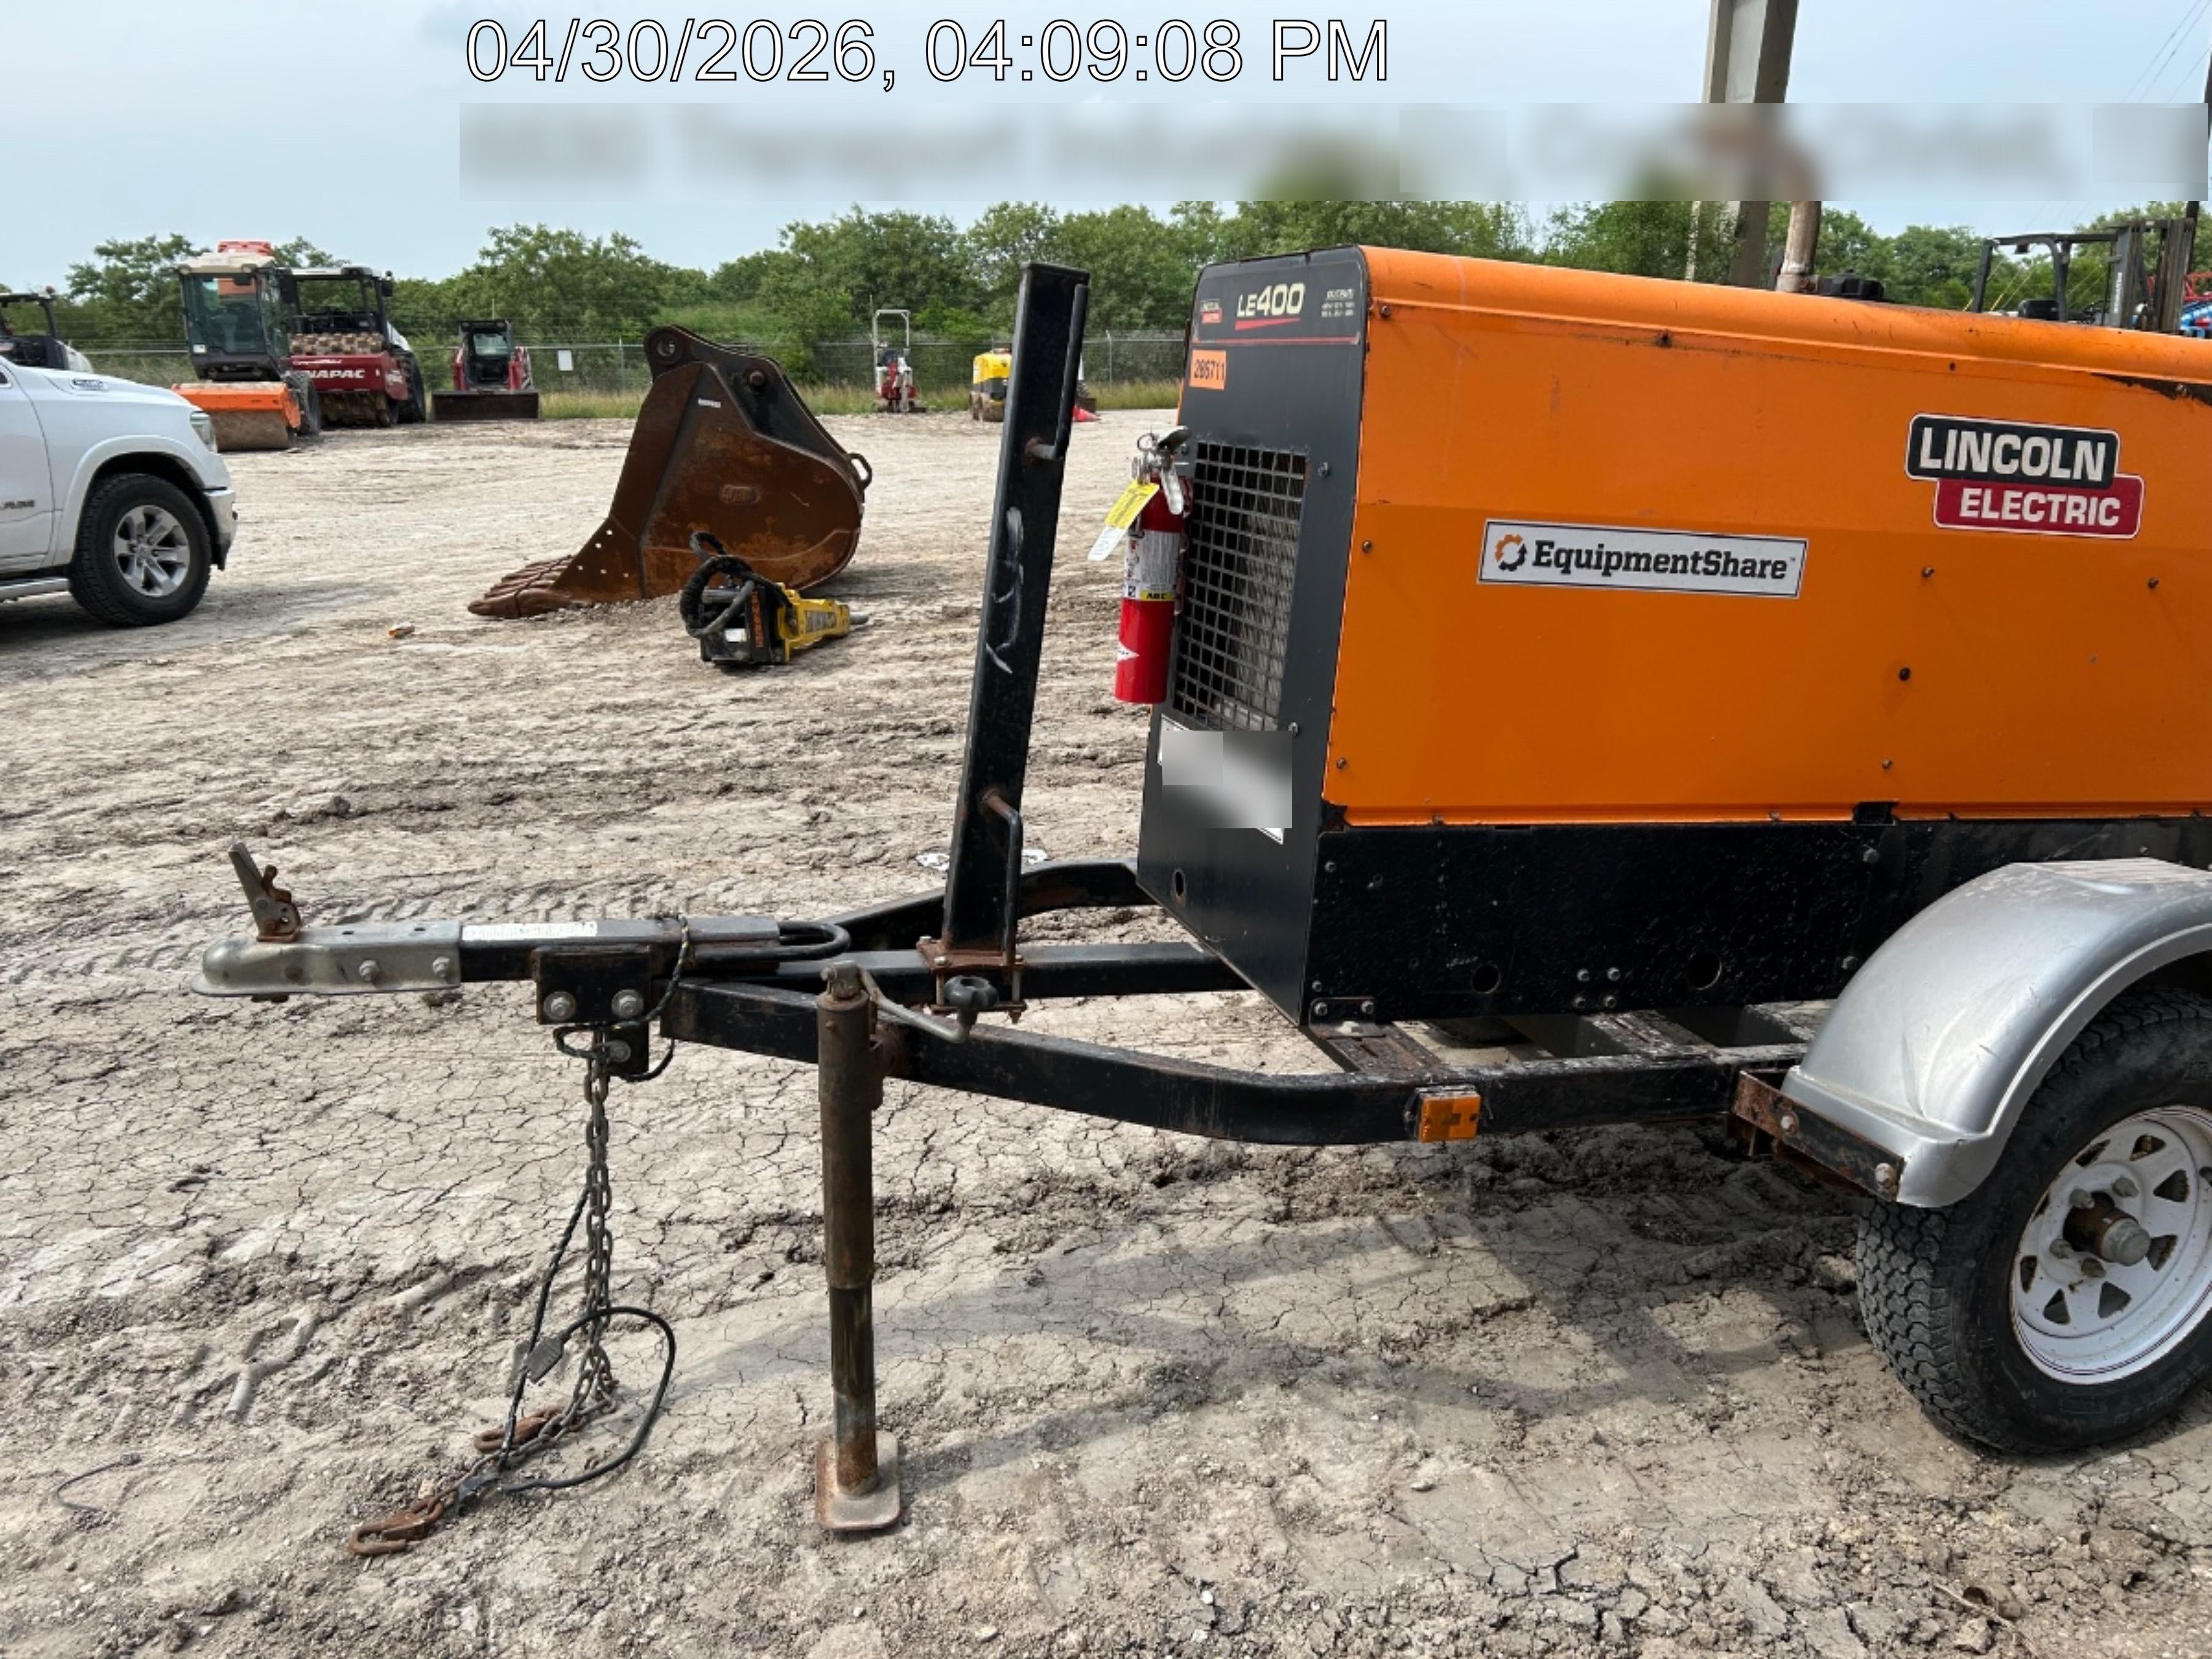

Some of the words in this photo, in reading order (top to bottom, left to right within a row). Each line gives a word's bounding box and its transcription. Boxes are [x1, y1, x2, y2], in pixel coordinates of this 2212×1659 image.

[1236, 283, 1305, 318] LE400
[1920, 427, 2106, 482] LINCOLN
[1959, 487, 2121, 527] ELECTRIC
[1532, 540, 1787, 579] EquipmentShare
